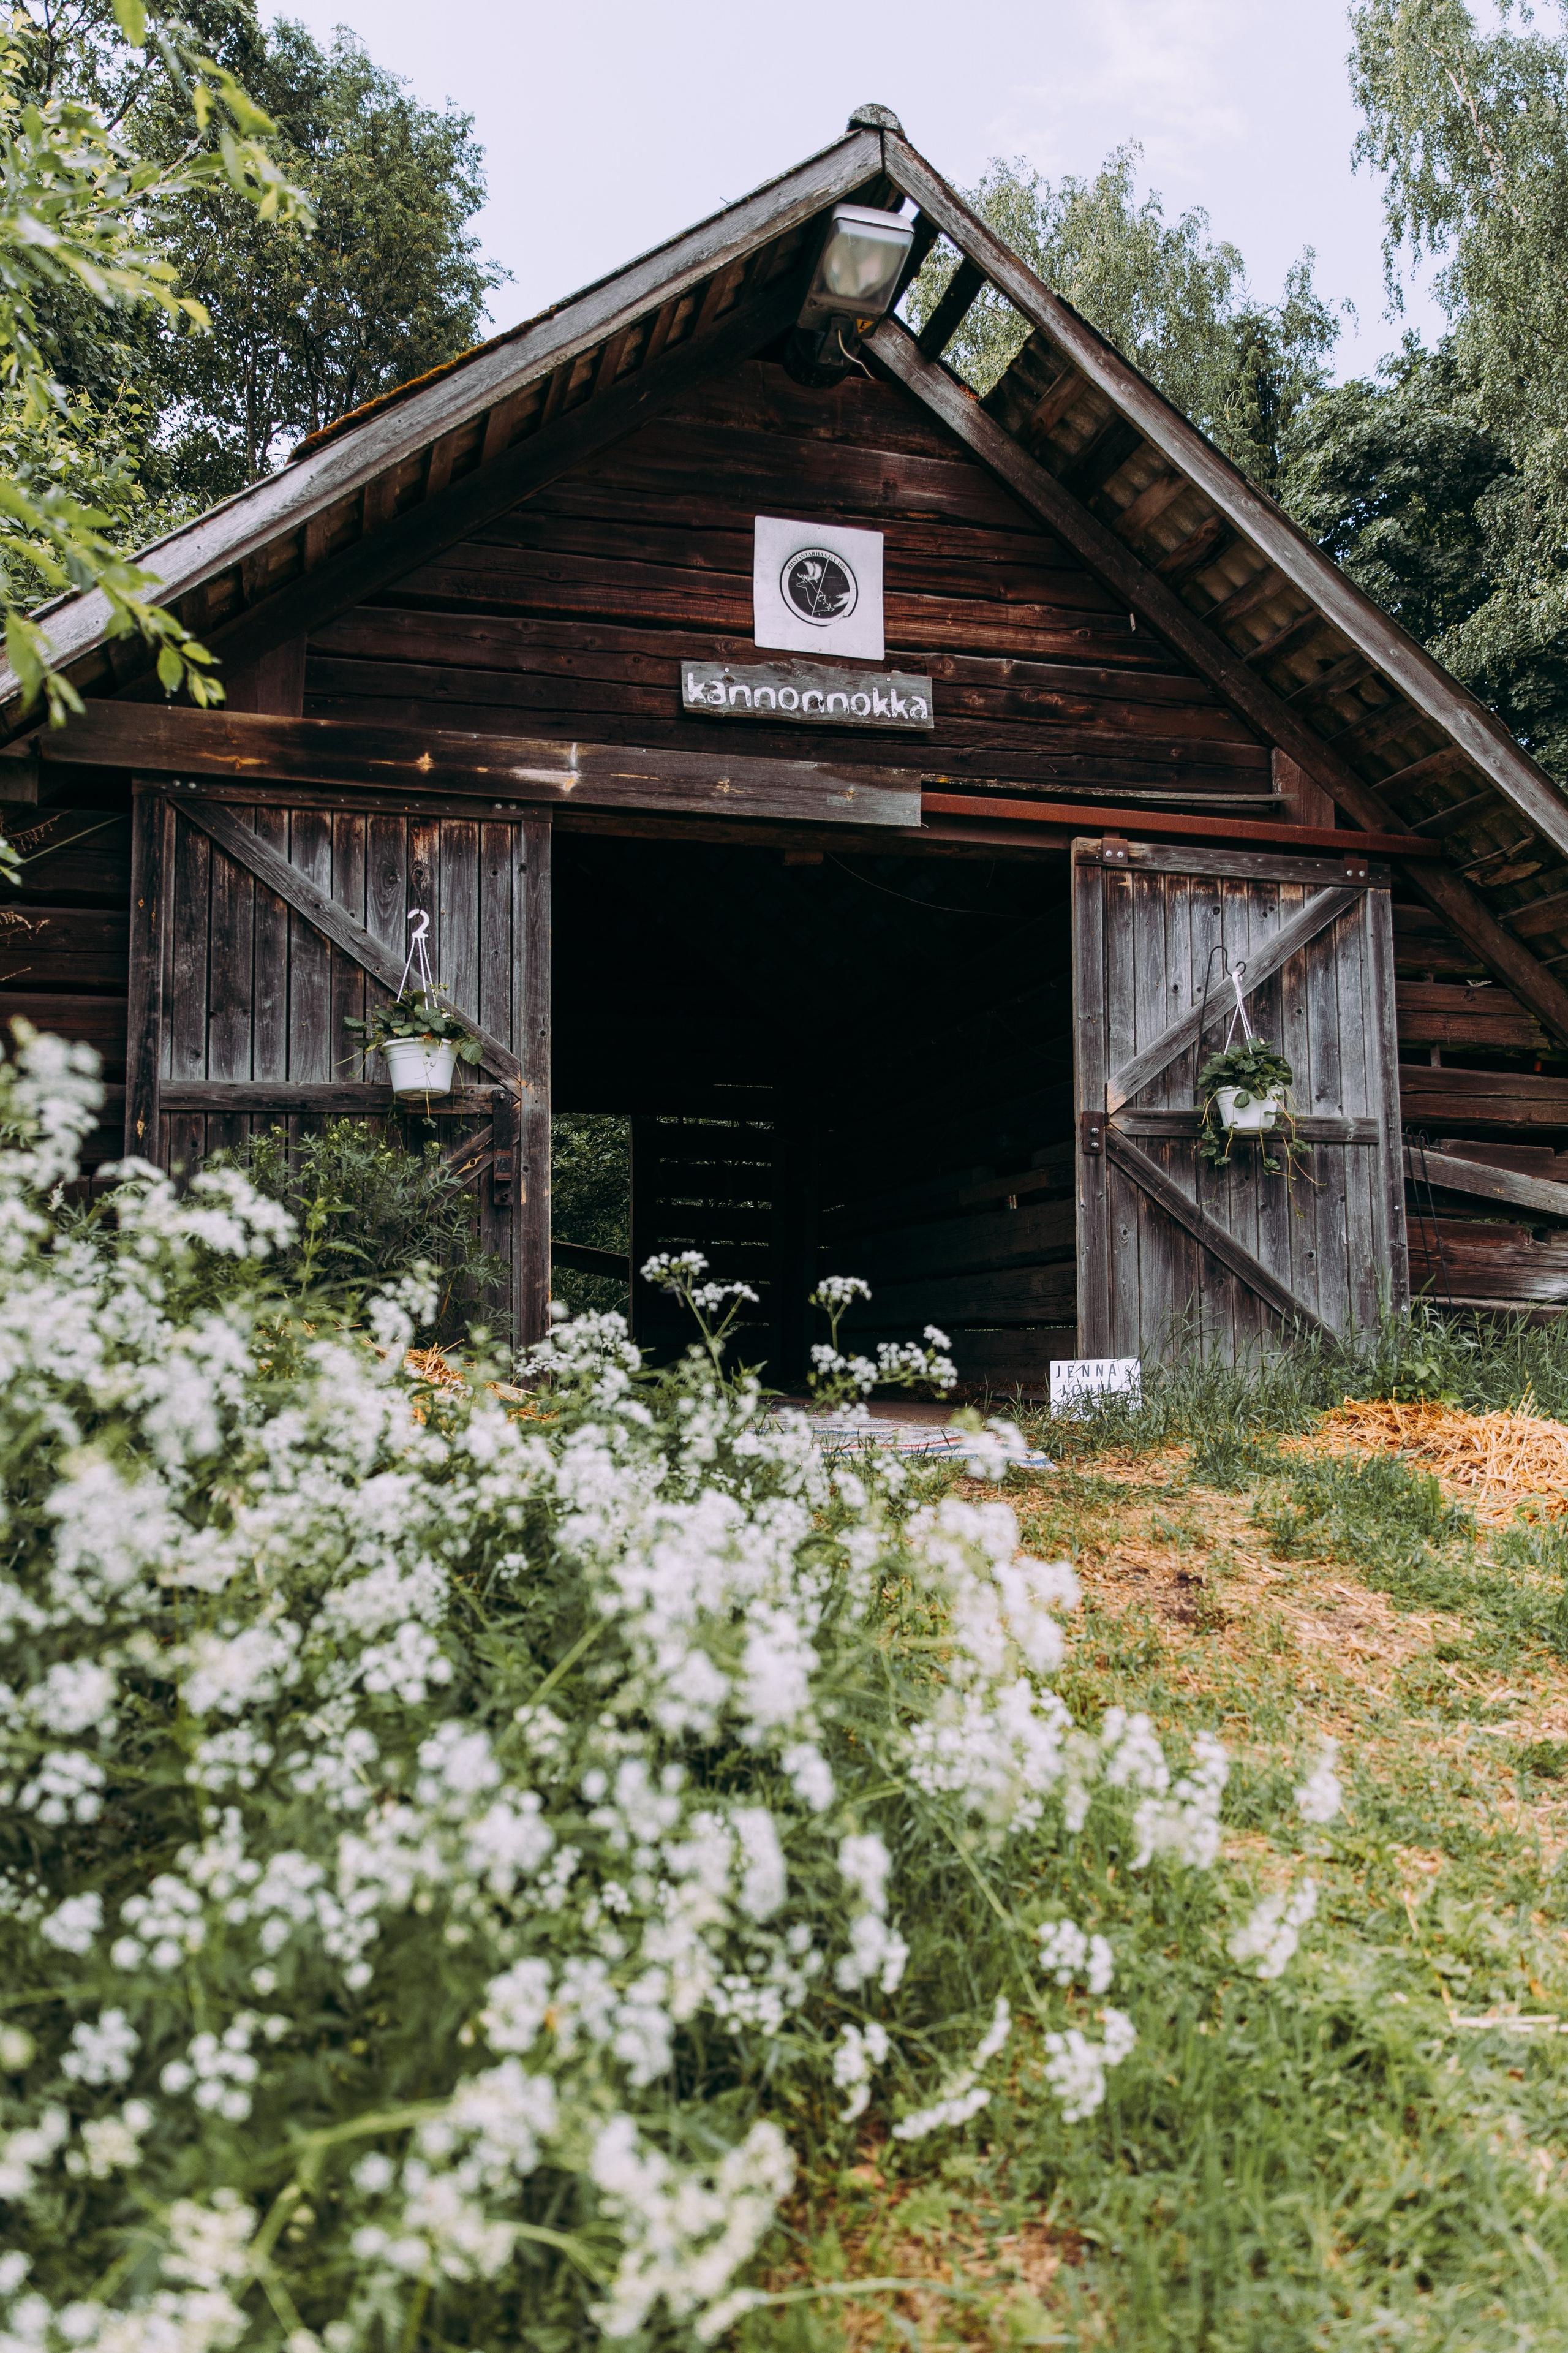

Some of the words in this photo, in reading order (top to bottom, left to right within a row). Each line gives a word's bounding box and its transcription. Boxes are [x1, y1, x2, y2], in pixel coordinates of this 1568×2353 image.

[786, 551, 837, 570] RIISTANTARHAAJAT
[837, 561, 848, 572] 1995
[687, 672, 928, 720] kannonnokka
[1056, 1364, 1117, 1378] JENNA
